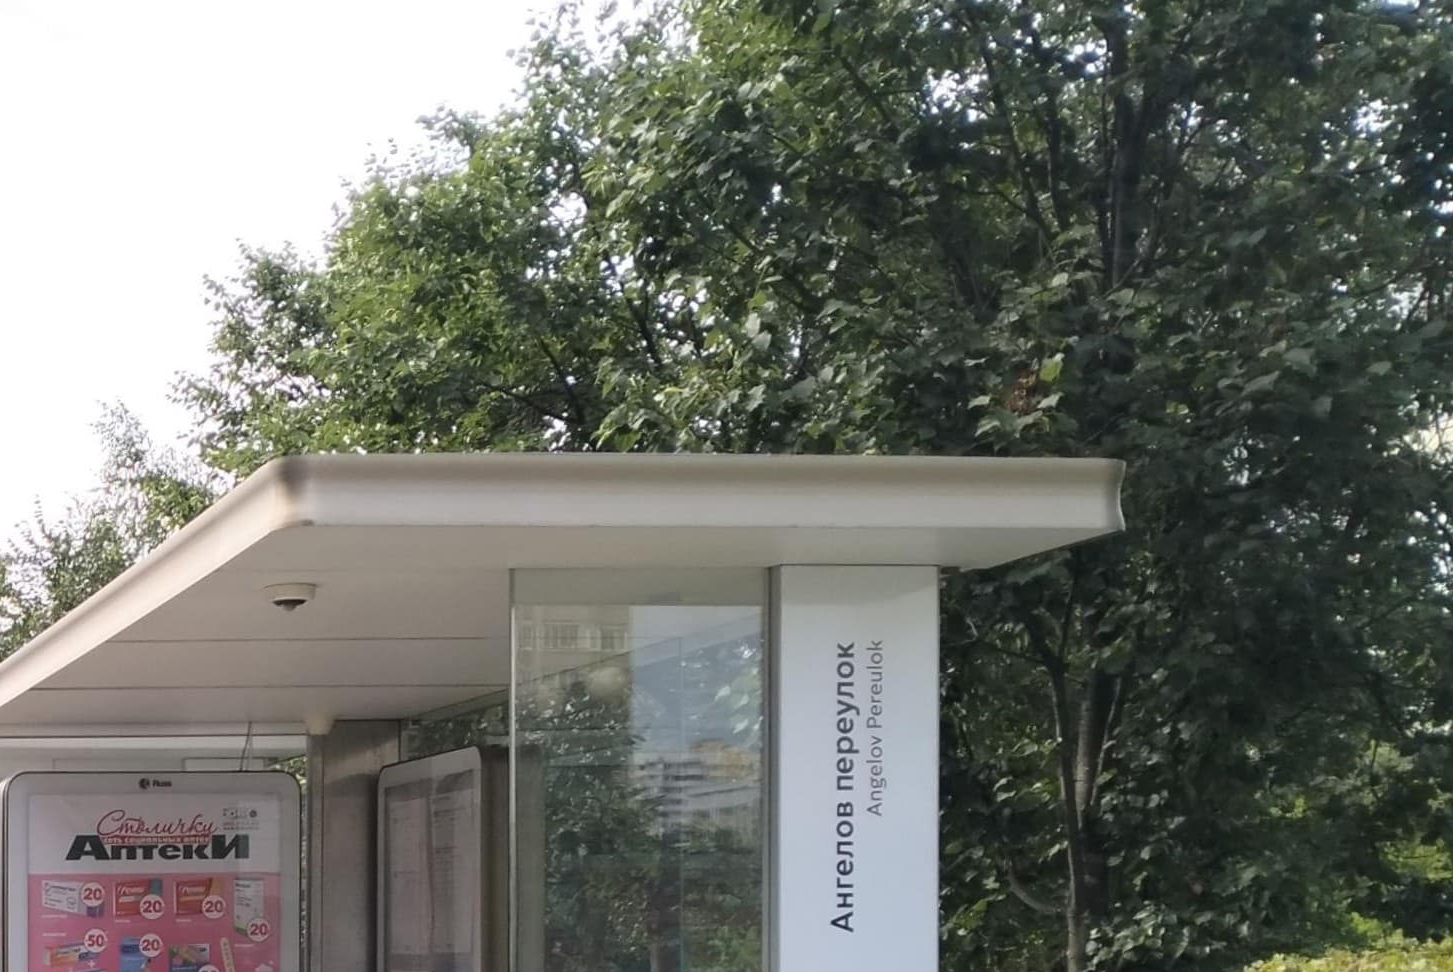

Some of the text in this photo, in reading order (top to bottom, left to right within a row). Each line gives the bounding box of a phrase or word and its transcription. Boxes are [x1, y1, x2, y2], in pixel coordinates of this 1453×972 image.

[830, 642, 860, 933] Ангелов переулок
[866, 640, 886, 817] Angelov Pereulok
[97, 809, 219, 836] Столички
